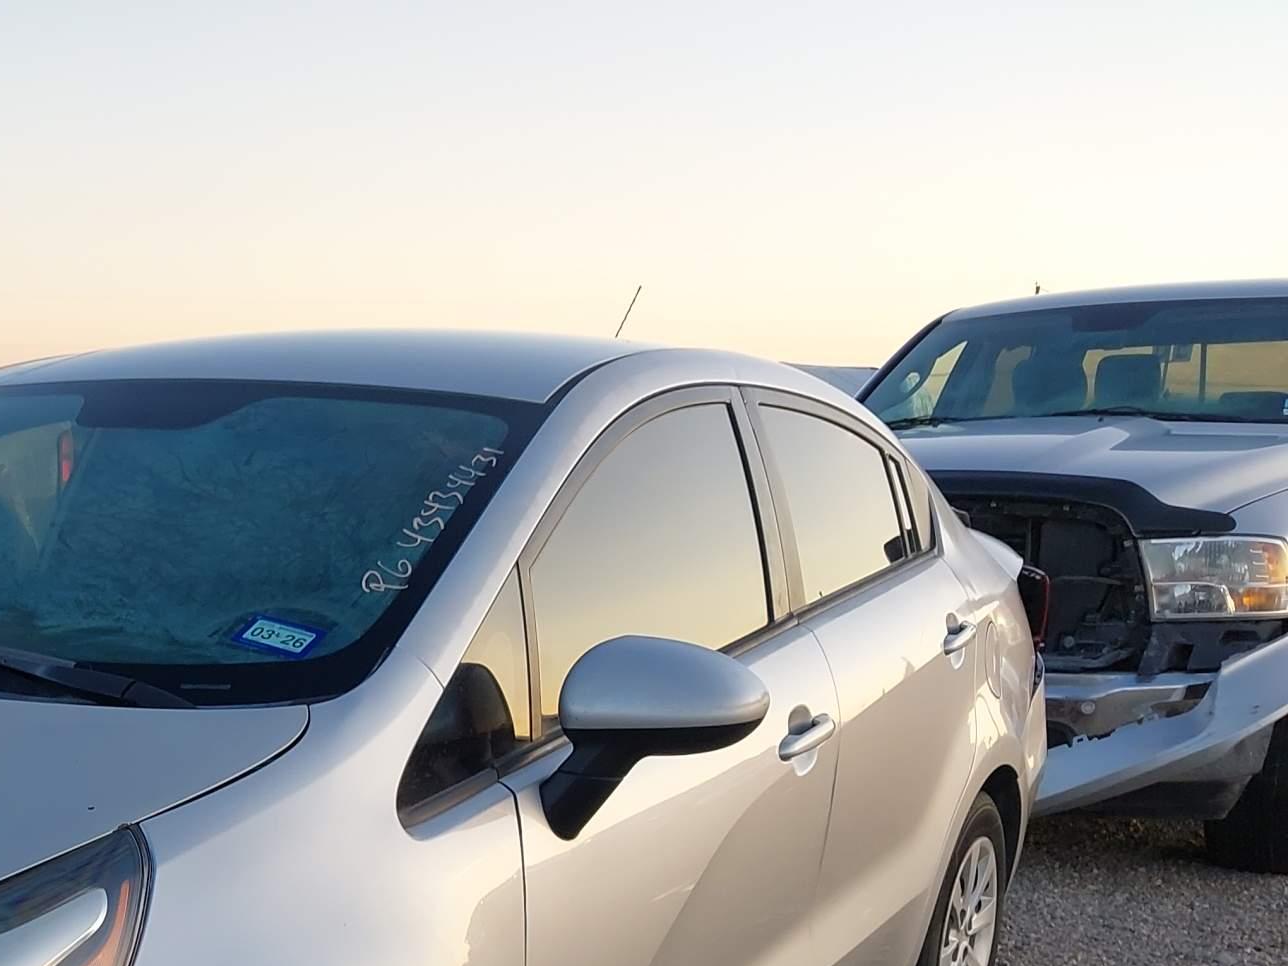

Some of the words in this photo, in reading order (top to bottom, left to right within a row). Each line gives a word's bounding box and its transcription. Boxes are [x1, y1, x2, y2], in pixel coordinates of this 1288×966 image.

[396, 447, 504, 548] 43434431
[250, 626, 275, 640] 03
[279, 634, 307, 649] 26
